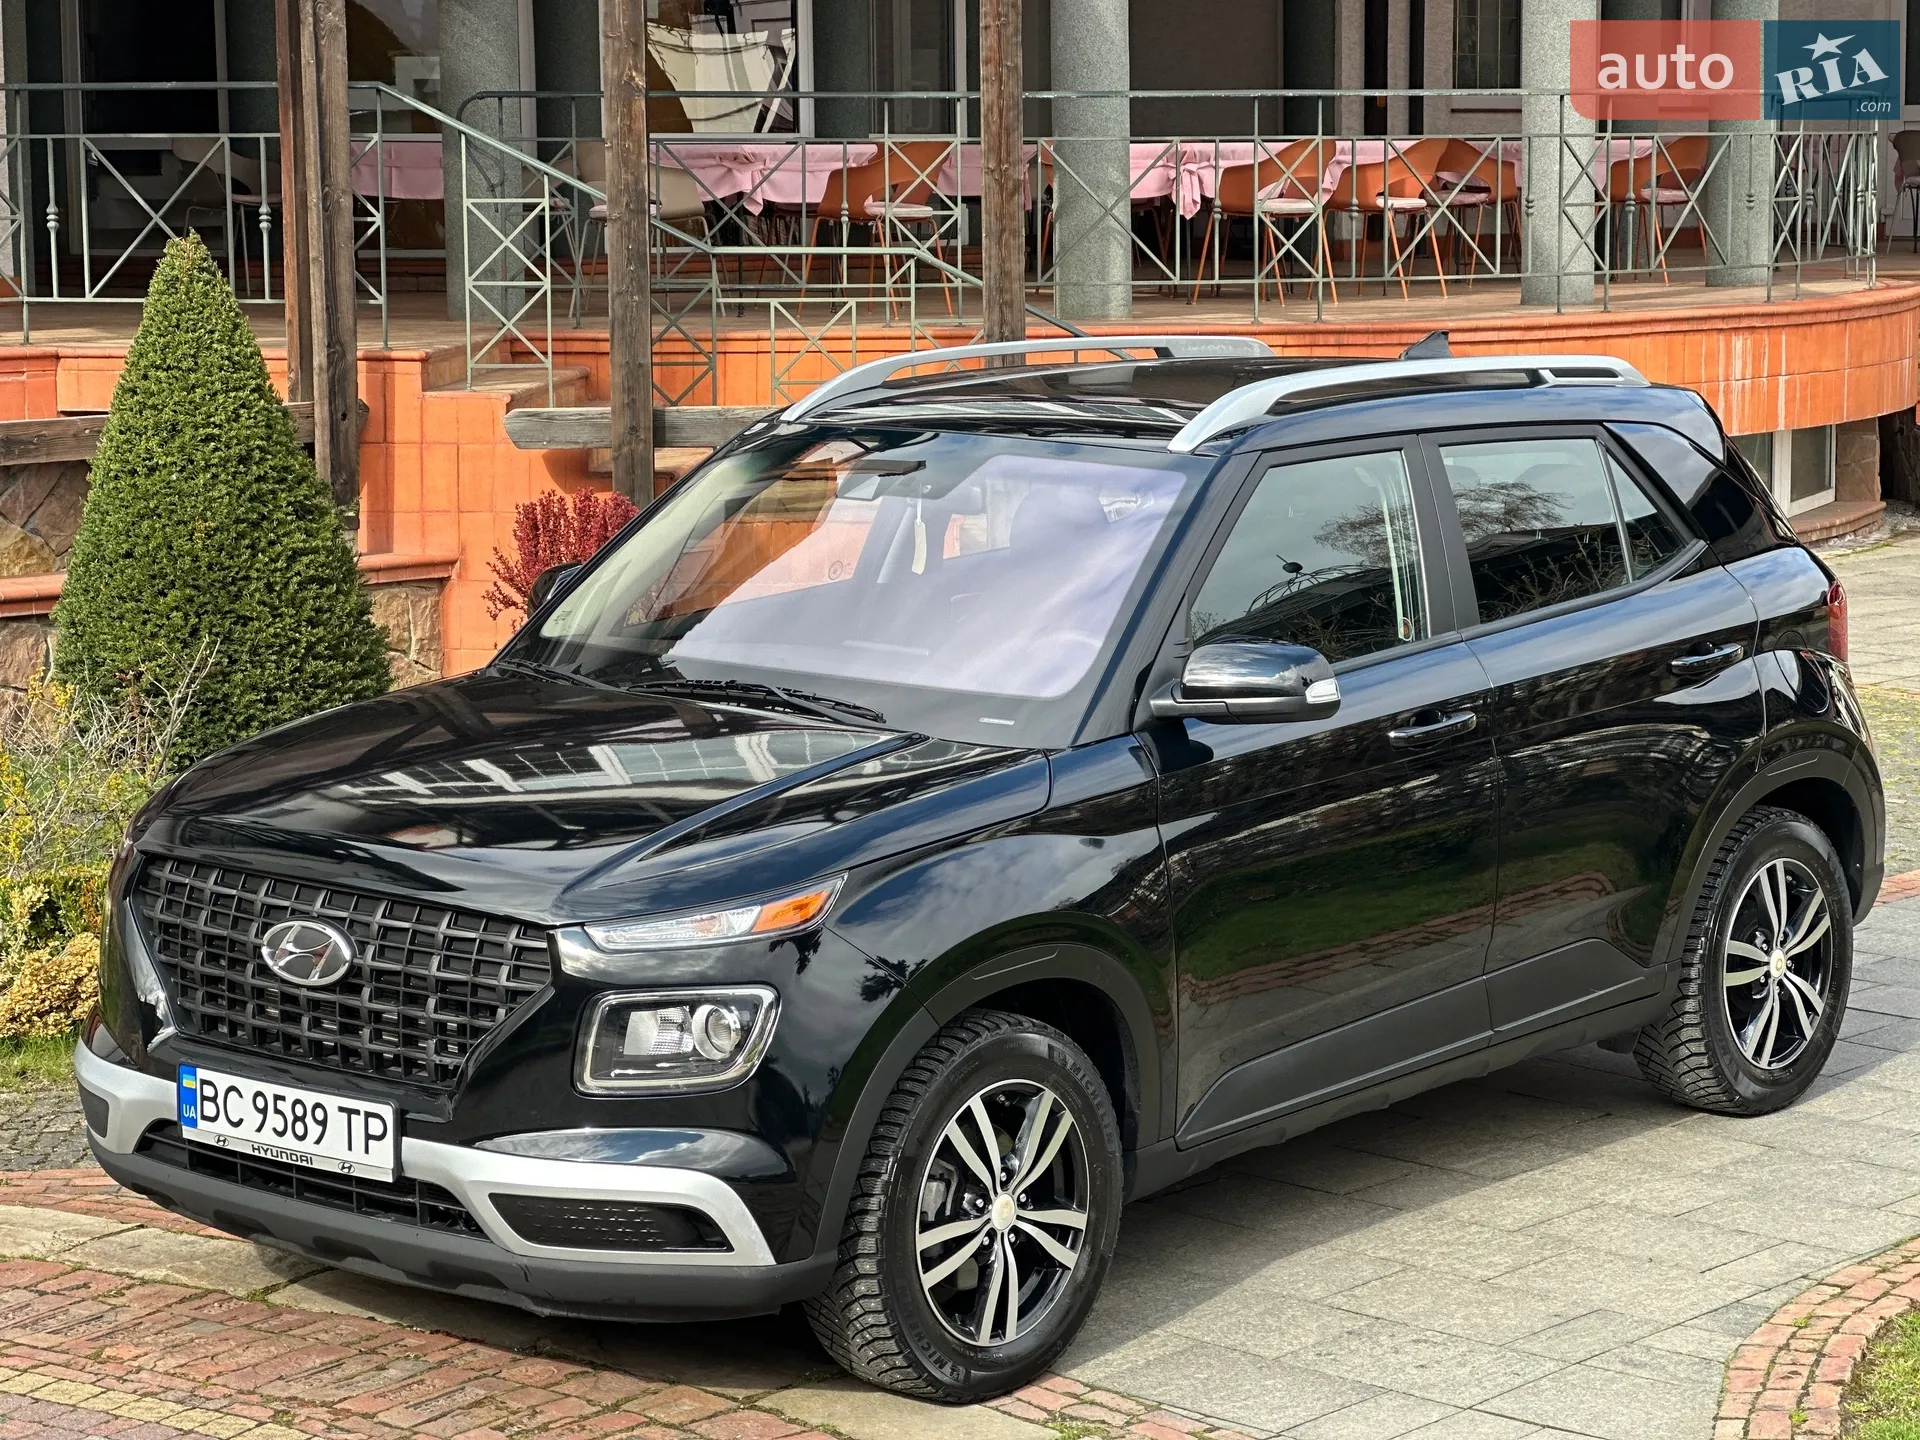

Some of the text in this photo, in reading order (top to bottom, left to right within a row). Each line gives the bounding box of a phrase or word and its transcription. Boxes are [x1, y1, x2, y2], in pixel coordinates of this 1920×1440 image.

[183, 1103, 197, 1120] UA
[199, 1078, 388, 1155] BC 9589 TP
[251, 1144, 313, 1166] HYUNDAI
